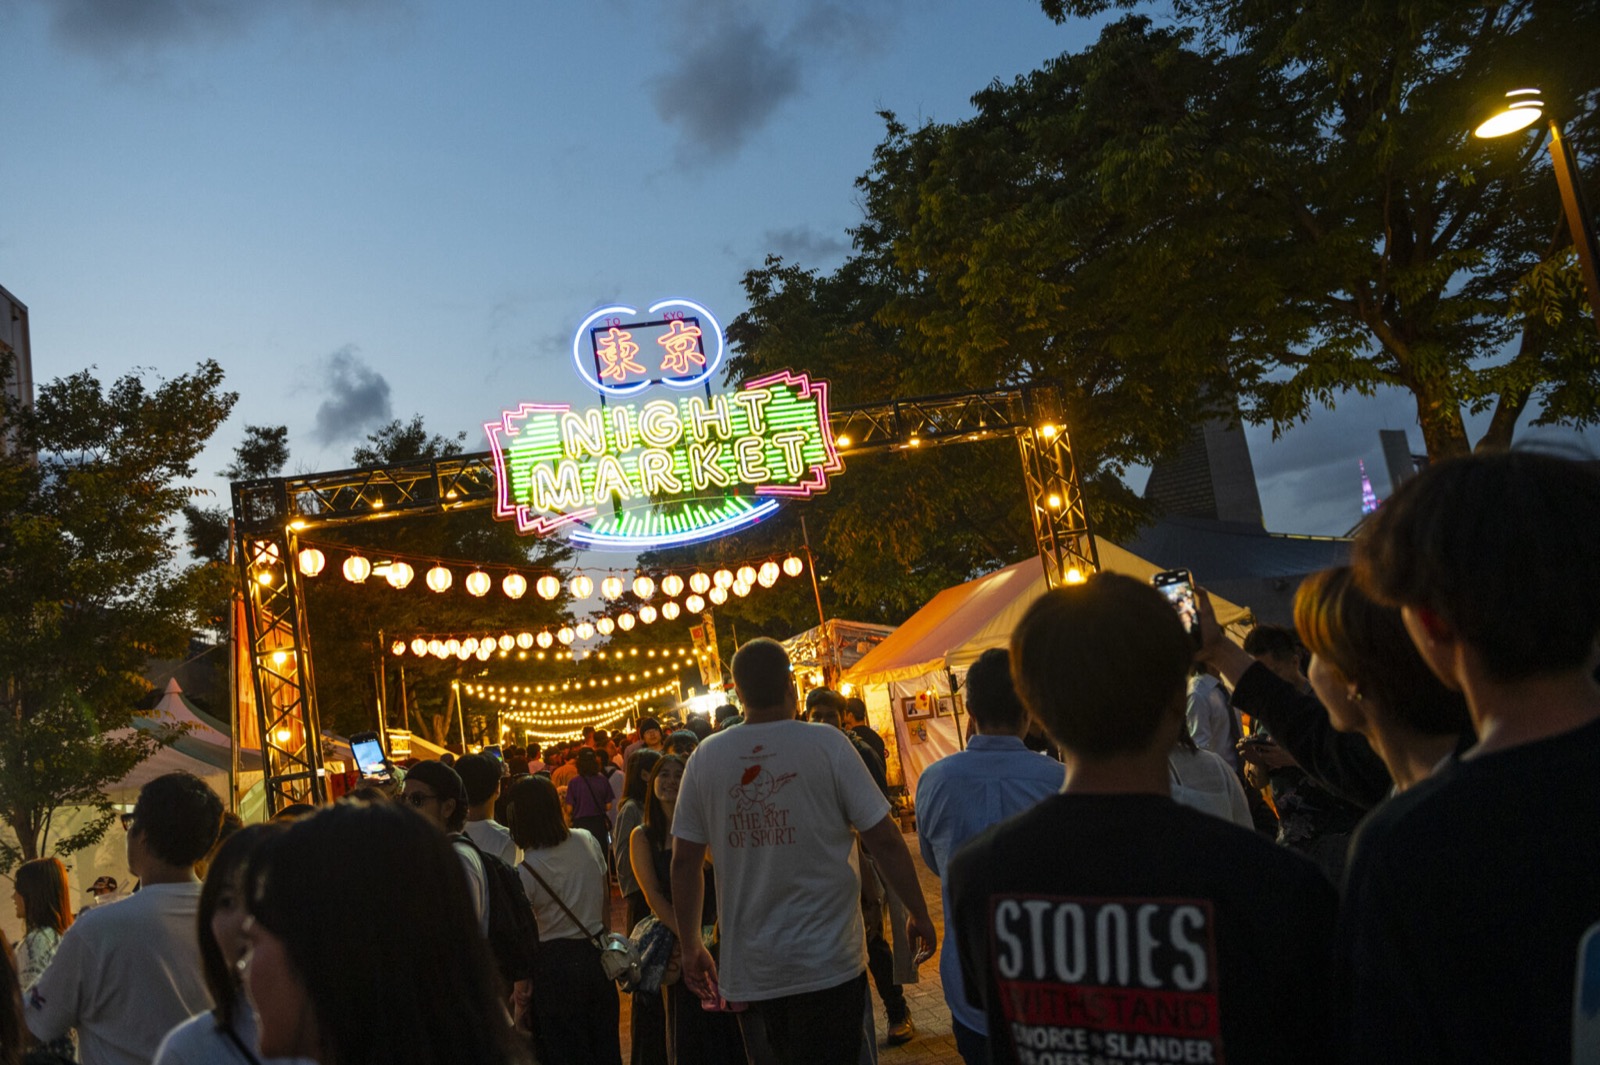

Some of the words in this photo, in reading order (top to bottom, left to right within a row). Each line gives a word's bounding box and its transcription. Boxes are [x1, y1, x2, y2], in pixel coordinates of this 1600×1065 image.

[605, 317, 621, 328] TO
[663, 310, 684, 321] KYO
[597, 320, 705, 381] 東京
[561, 388, 772, 460] NIGHT
[531, 432, 810, 513] MARKET
[728, 831, 746, 848] OF
[729, 812, 761, 831] THE
[763, 809, 789, 828] ART
[996, 900, 1207, 990] STONES
[1105, 1033, 1214, 1062] SLANDER
